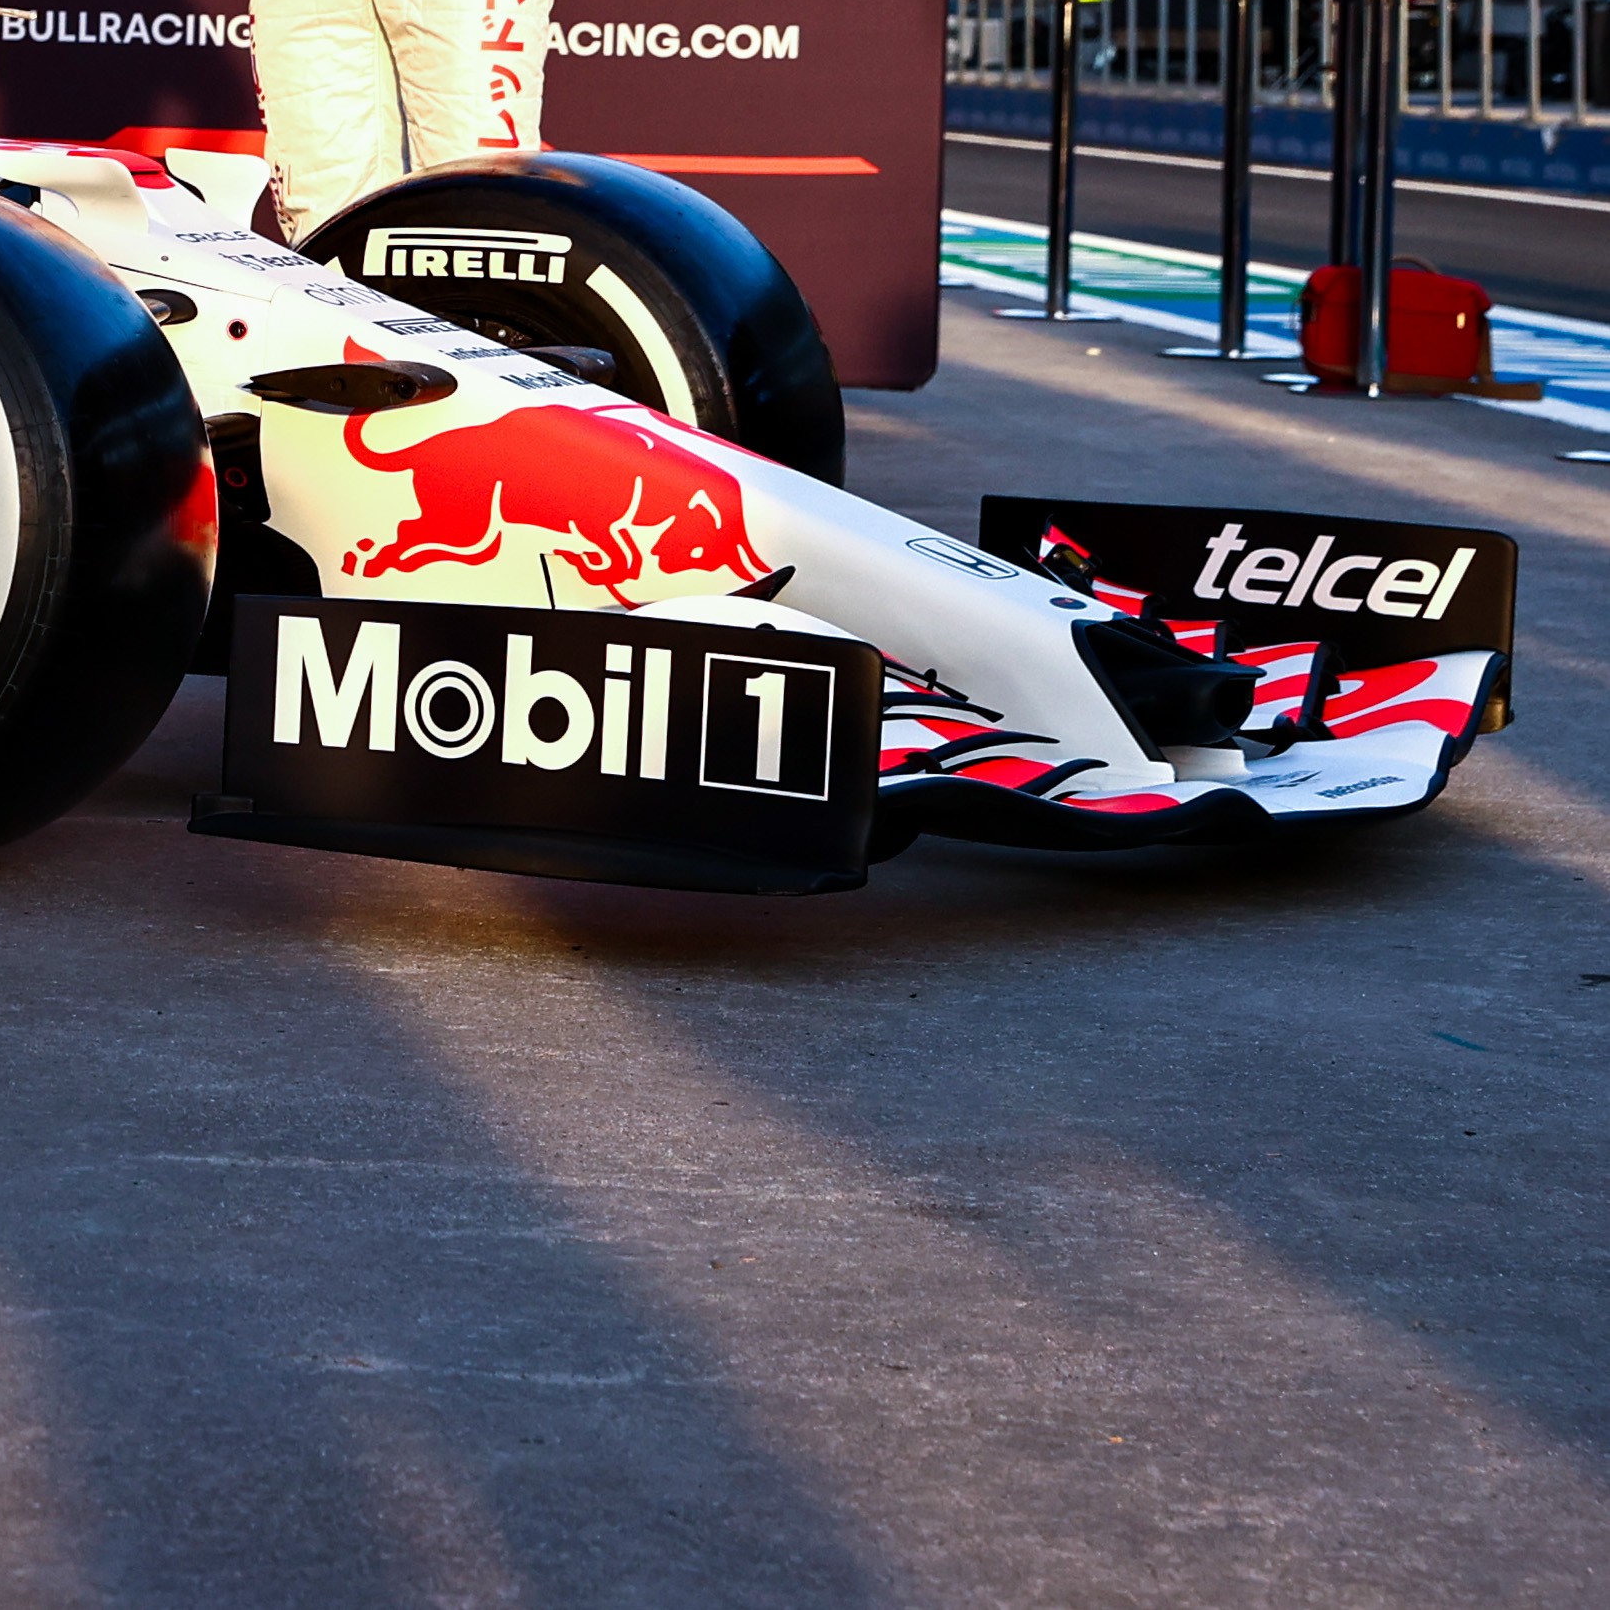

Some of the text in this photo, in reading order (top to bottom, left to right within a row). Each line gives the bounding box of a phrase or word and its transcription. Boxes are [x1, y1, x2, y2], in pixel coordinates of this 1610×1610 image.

[174, 230, 257, 244] ORACLE
[363, 228, 572, 284] PIRELLI
[372, 317, 462, 336] PIRELLI
[1191, 521, 1476, 621] telcel
[274, 616, 672, 781] Mobil
